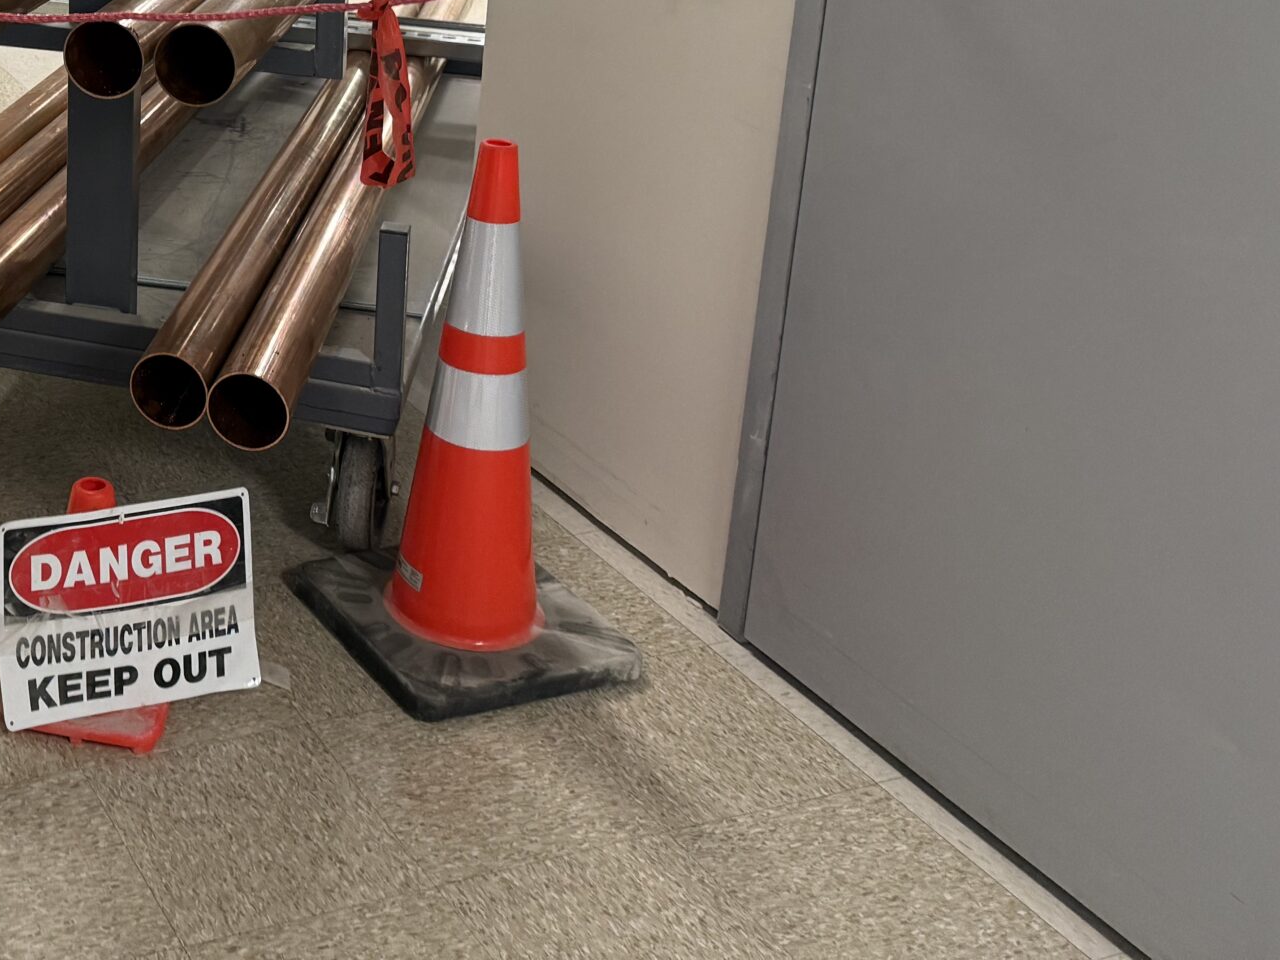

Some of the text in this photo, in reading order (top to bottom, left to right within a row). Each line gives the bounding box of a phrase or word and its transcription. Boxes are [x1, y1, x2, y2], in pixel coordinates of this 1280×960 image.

[30, 530, 223, 592] DANGER
[15, 605, 240, 670] CONSTRUCTION AREA
[27, 647, 232, 712] KEEP OUT
